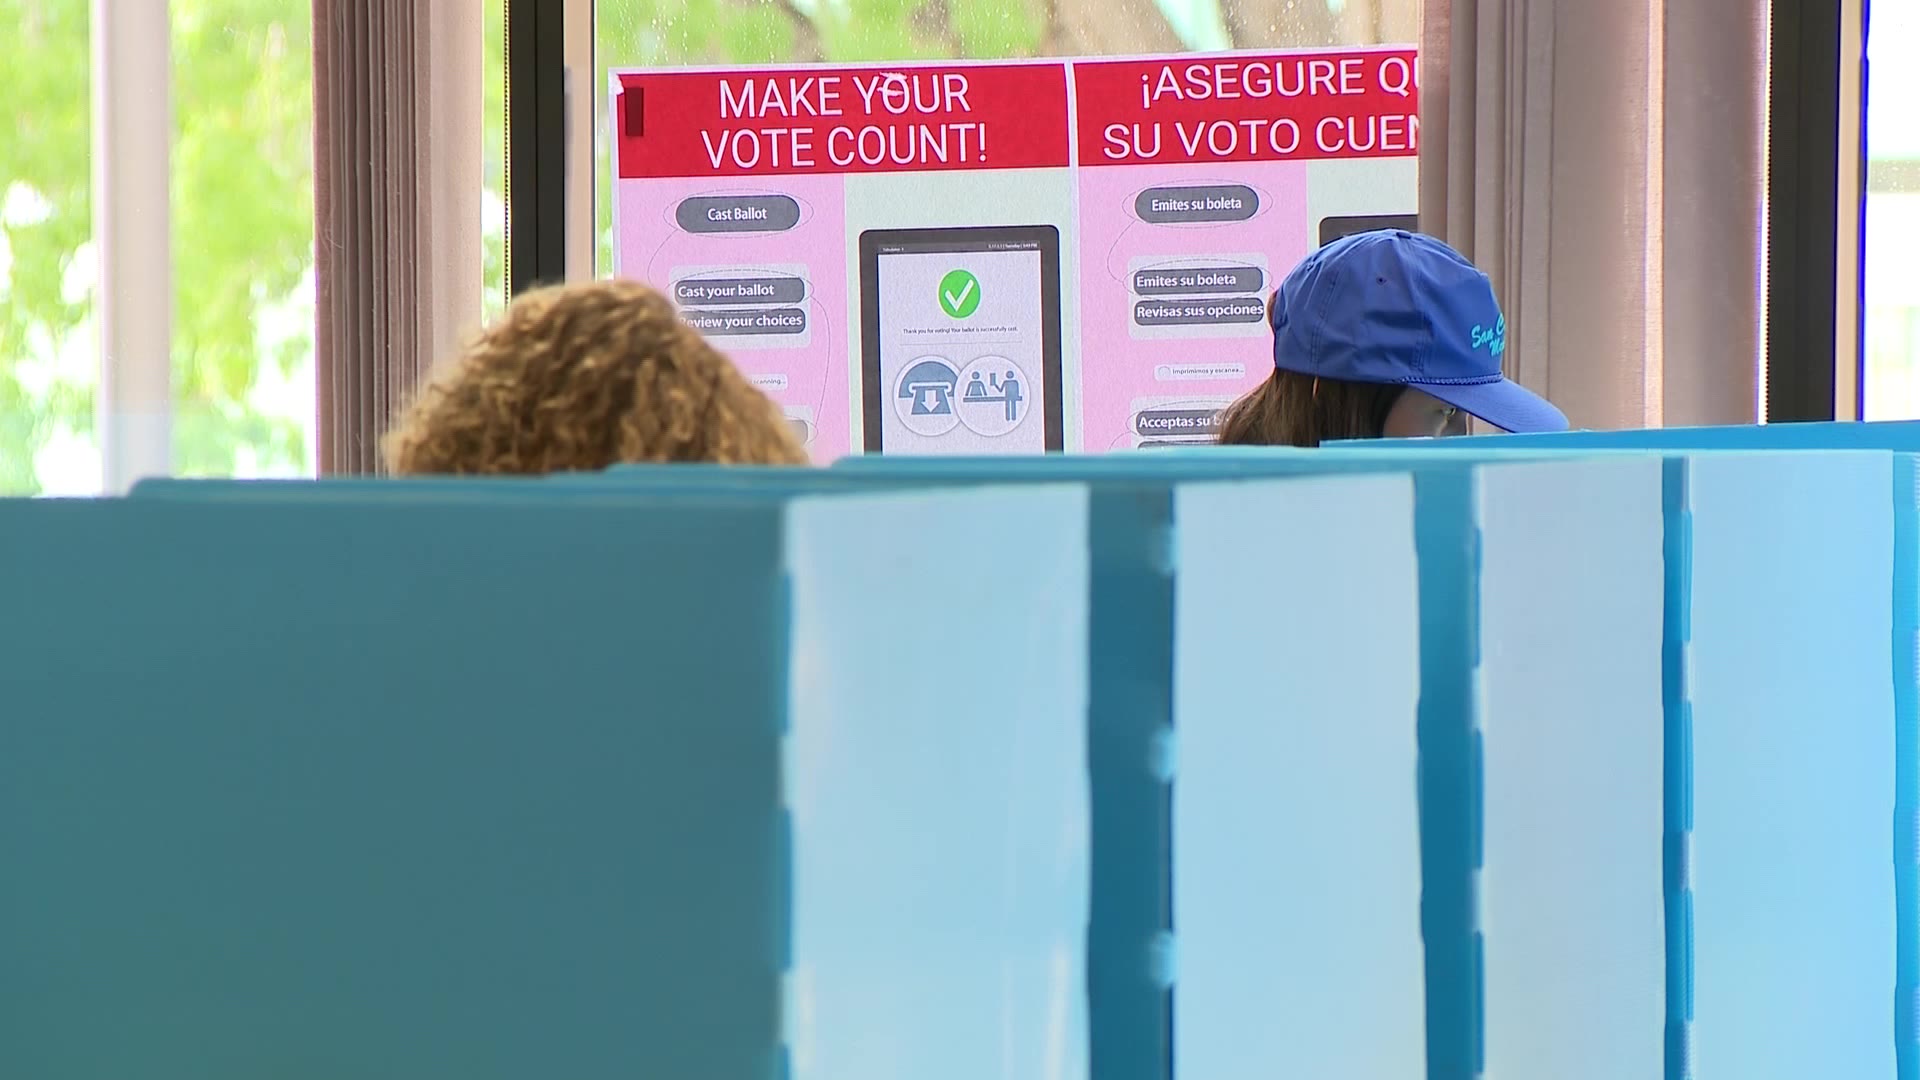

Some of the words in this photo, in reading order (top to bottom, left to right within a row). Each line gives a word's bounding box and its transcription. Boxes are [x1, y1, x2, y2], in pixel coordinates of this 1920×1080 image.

[1141, 58, 1365, 109] ¡ASEGURE
[1379, 57, 1418, 97] Q
[719, 77, 843, 118] MAKE
[853, 73, 971, 115] YOUR
[701, 127, 815, 169] VOTE
[827, 122, 987, 165] COUNT!
[1104, 122, 1161, 158] SU
[1175, 118, 1300, 156] VOTO
[1151, 199, 1189, 212] Emites
[1191, 201, 1204, 211] su
[1206, 196, 1242, 210] boleta
[707, 208, 732, 221] Cast
[734, 206, 767, 220] Ballot
[1136, 275, 1178, 288] Emites
[1180, 277, 1195, 286] su
[1197, 273, 1236, 286] boleta
[678, 285, 705, 297] Cast
[707, 286, 735, 299] your
[738, 283, 774, 296] ballot
[1137, 304, 1182, 318] Revisas
[1184, 306, 1205, 317] sus
[1207, 302, 1264, 319] opciones
[725, 317, 753, 330] your
[755, 313, 803, 326] choices
[1471, 324, 1494, 349] San
[1139, 416, 1194, 430] Acceptas
[1196, 417, 1210, 427] su
